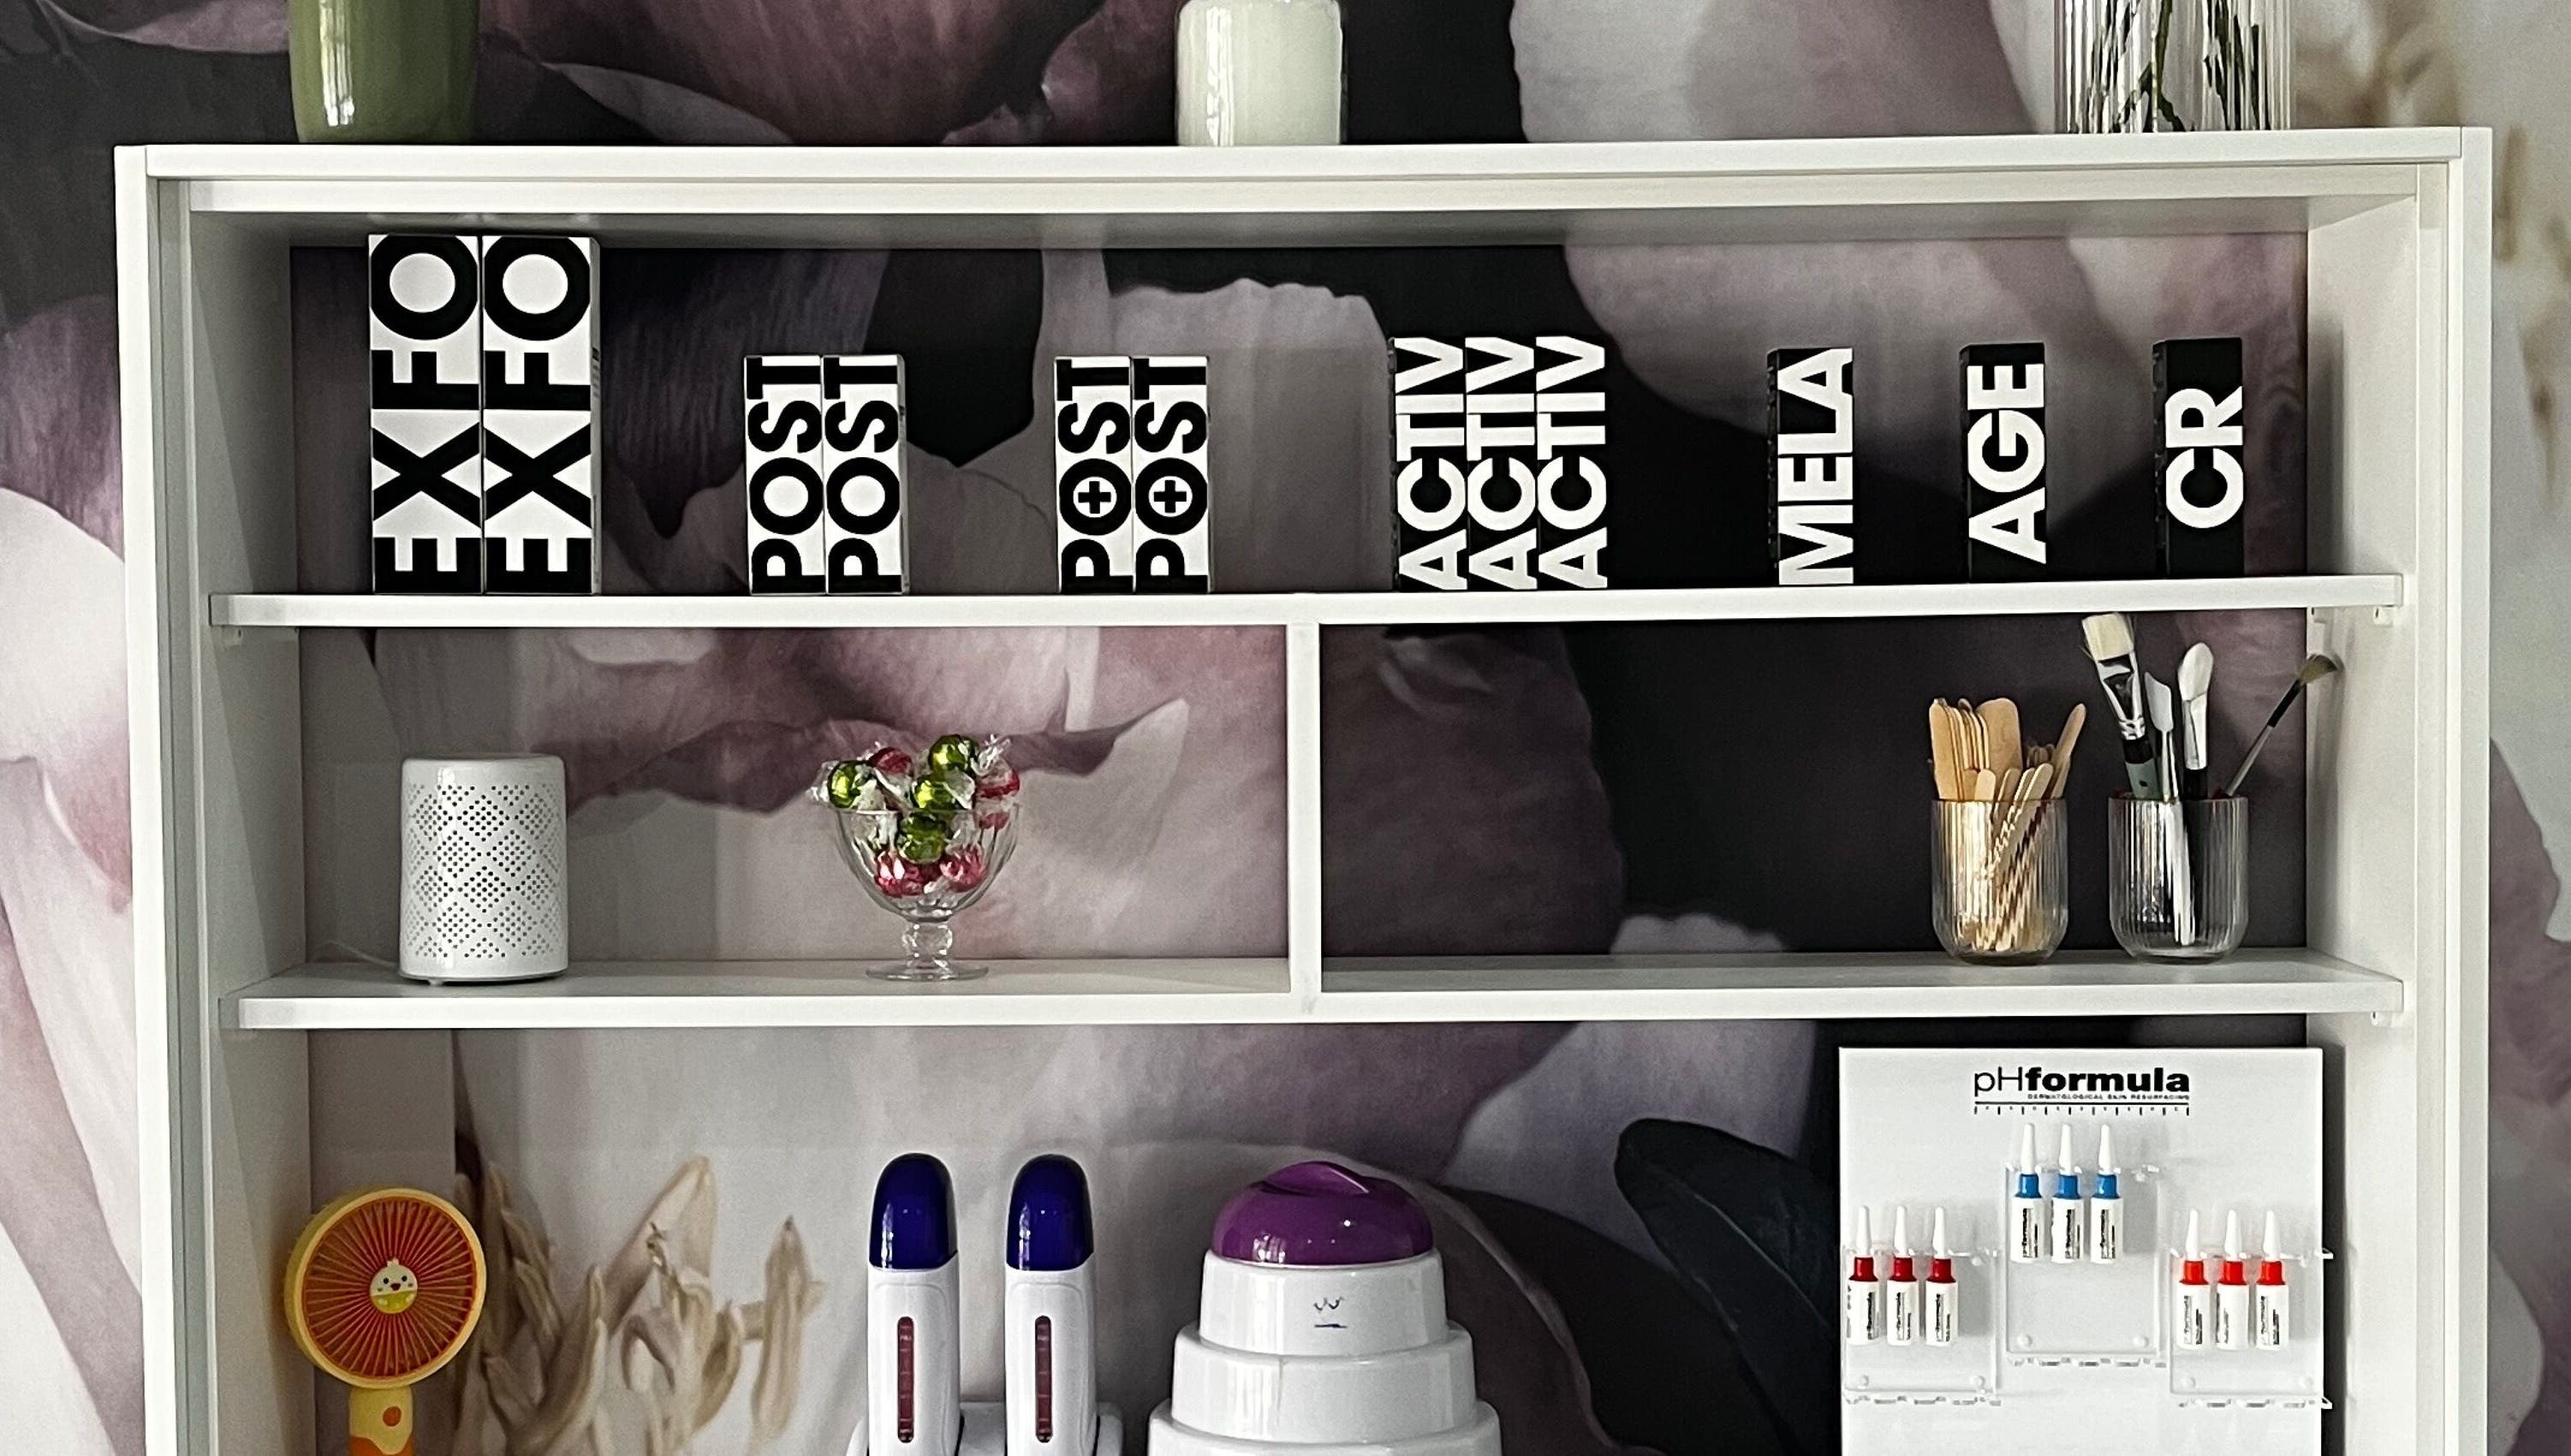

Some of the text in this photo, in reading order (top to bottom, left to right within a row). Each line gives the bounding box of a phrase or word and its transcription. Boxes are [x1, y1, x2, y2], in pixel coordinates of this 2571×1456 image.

[370, 235, 482, 593] EXFO
[483, 235, 592, 593] EXFO
[745, 357, 824, 593] POST
[823, 357, 902, 593] POST
[1394, 337, 1467, 590] ACTIV
[1465, 336, 1537, 590] ACTIV
[1535, 336, 1607, 589] ACTIV
[1776, 348, 1854, 585] MELA
[1967, 363, 2047, 564] AGE
[2164, 386, 2245, 528] CR
[1974, 1066, 2190, 1097] pHformula
